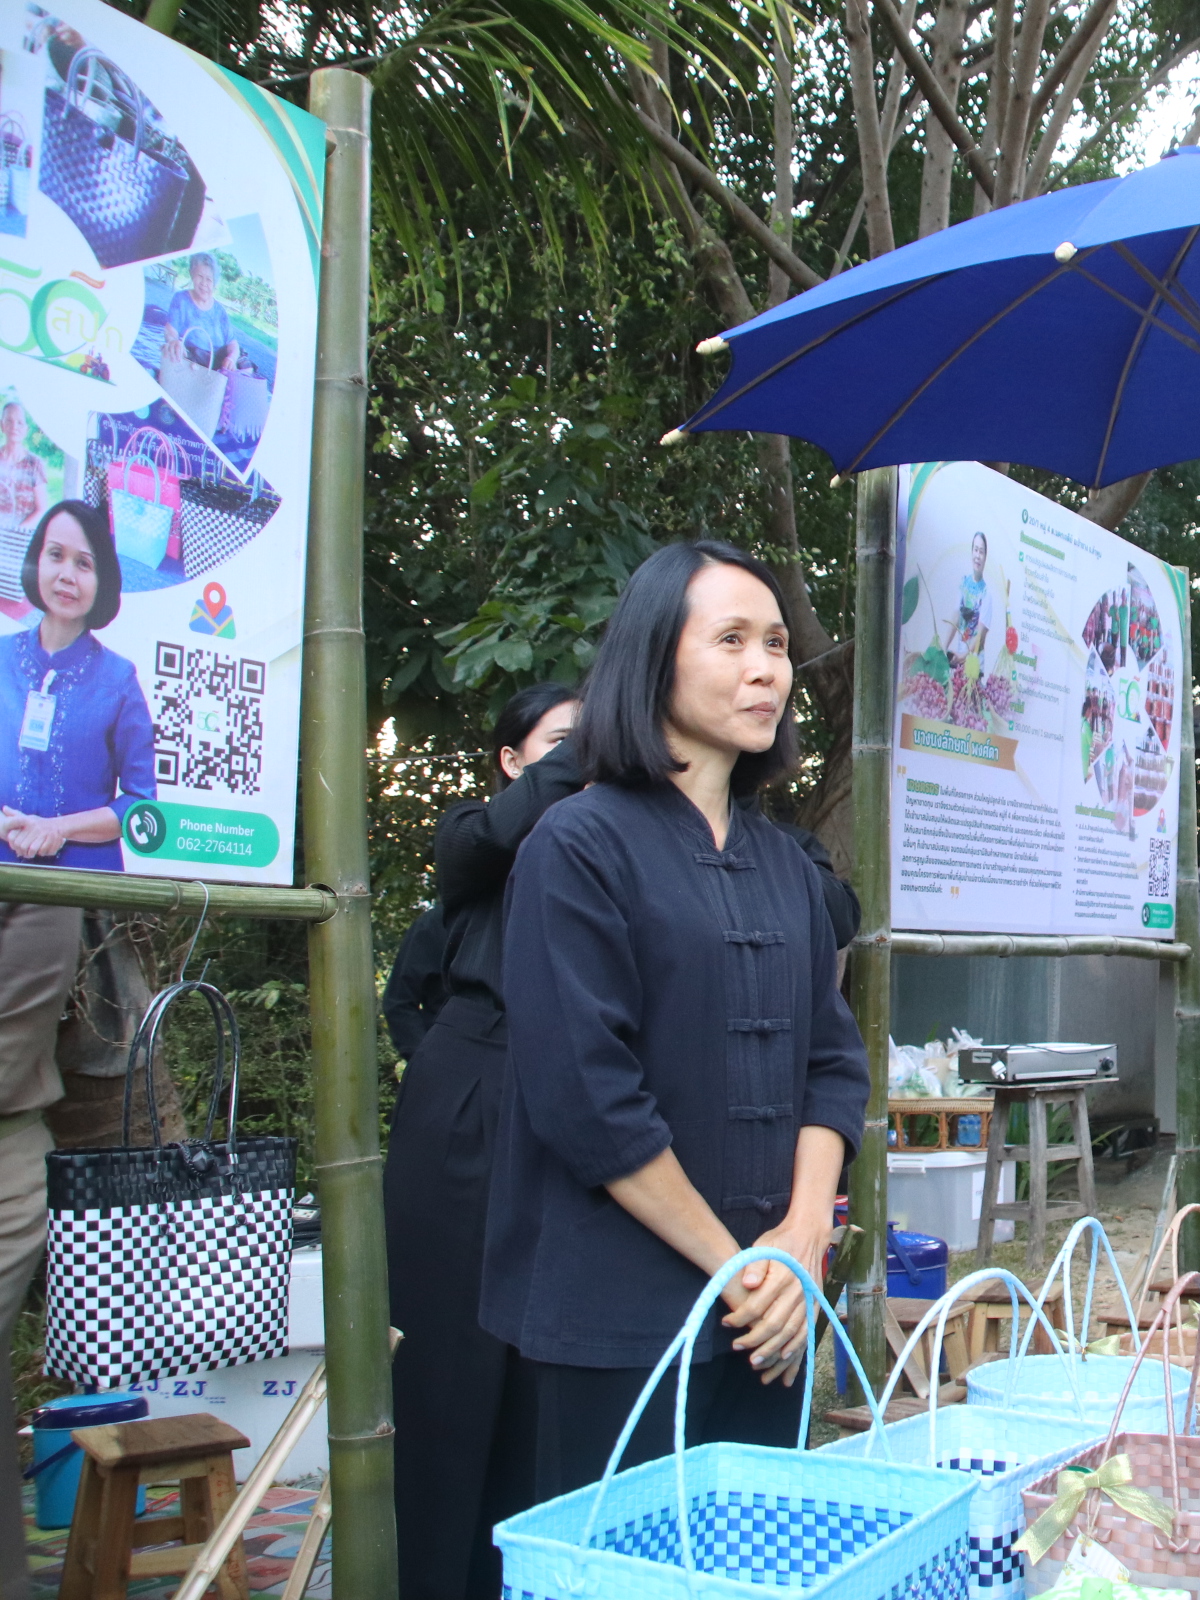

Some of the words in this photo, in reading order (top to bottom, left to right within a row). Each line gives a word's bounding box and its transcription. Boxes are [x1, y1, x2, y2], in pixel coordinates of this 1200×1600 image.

[180, 819, 213, 833] Phone
[215, 822, 255, 837] Number
[177, 836, 252, 855] 062-2764114
[174, 1381, 207, 1397] ZJ
[263, 1381, 297, 1396] ZJ
